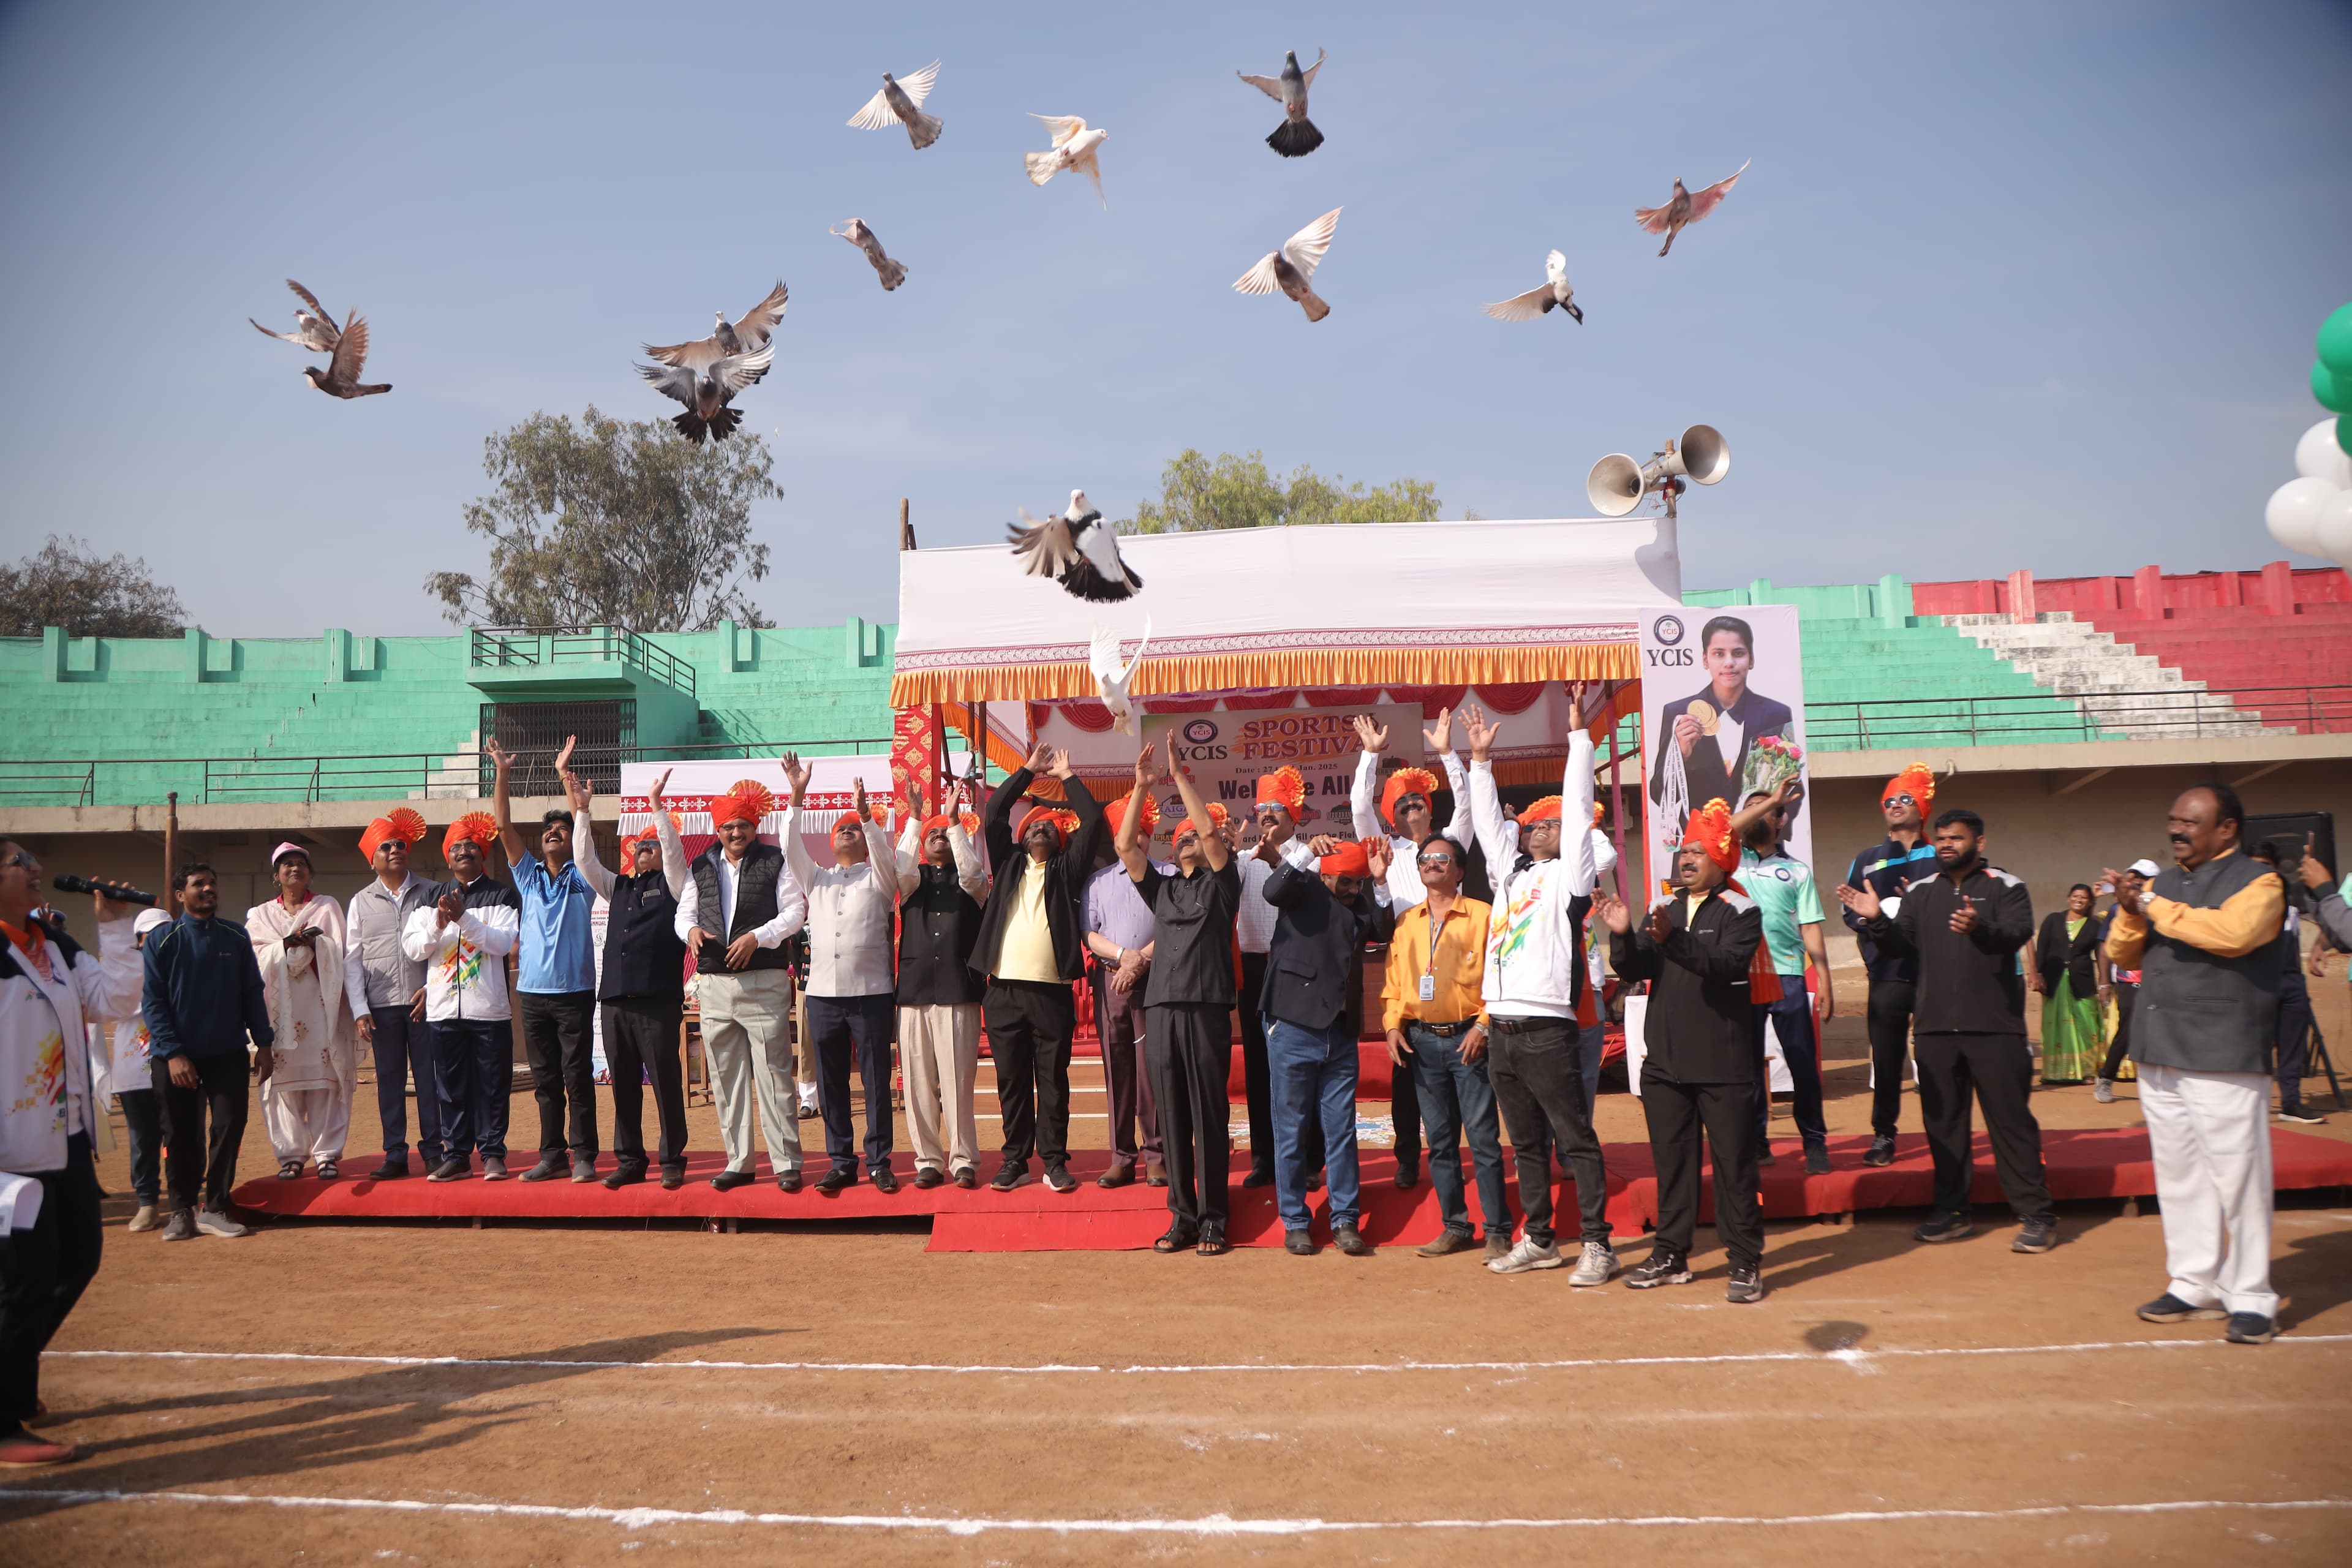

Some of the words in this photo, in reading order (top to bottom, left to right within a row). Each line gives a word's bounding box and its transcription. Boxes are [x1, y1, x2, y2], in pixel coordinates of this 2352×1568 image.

[1646, 648, 1694, 666] YCIS
[1243, 715, 1358, 739] SPORTS
[1177, 745, 1228, 761] YCIS
[1243, 735, 1389, 760] FESTIVA
[1218, 778, 1315, 800] Wele
[1322, 775, 1351, 795] All
[1339, 831, 1357, 839] Fiel
